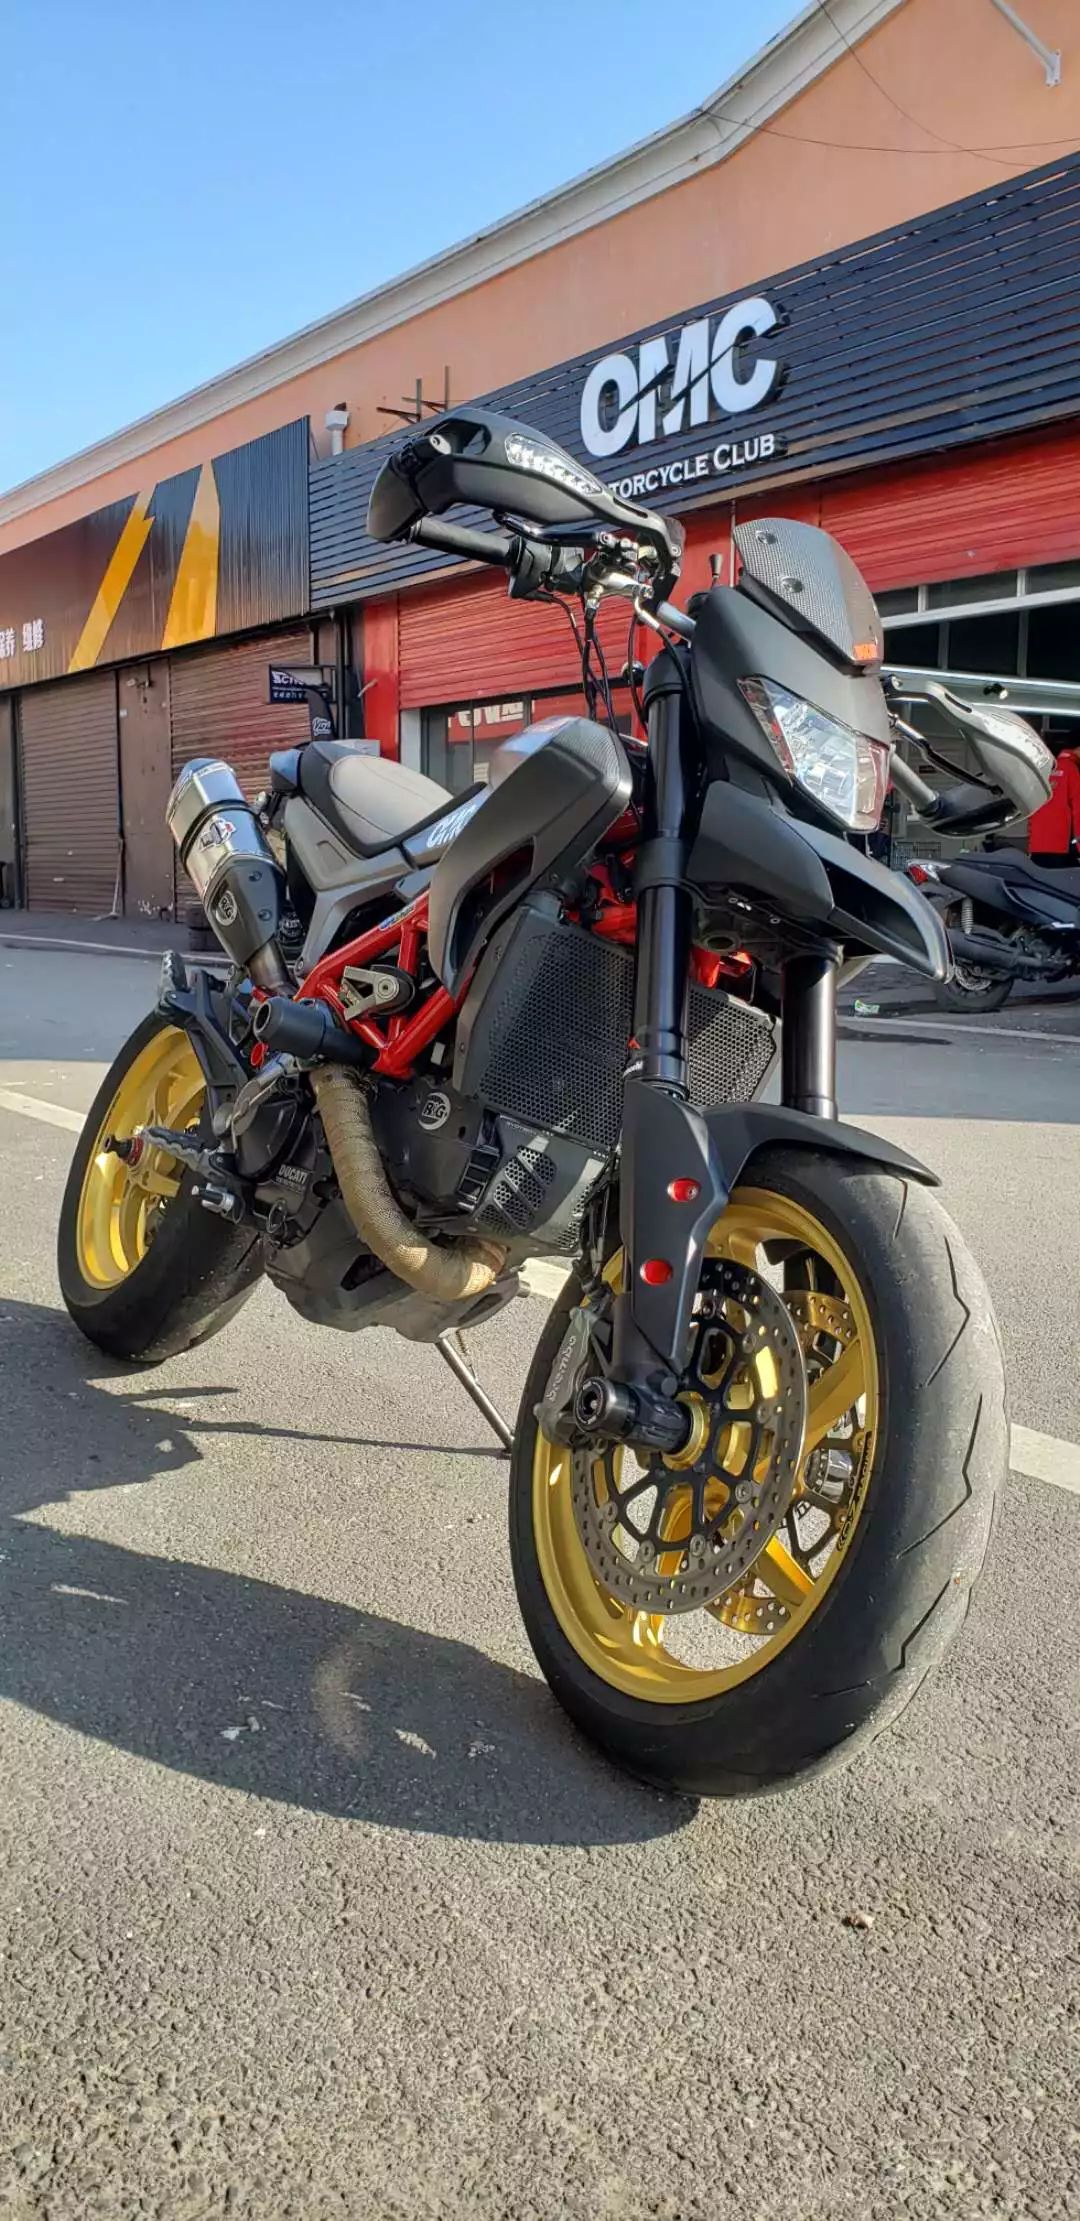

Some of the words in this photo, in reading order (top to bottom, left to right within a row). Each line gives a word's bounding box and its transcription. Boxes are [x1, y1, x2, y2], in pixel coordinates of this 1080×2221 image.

[580, 297, 780, 458] OMC
[607, 453, 710, 498] TORCYCLE
[713, 434, 775, 469] CLUB
[278, 1164, 308, 1185] DUCATI
[545, 1336, 577, 1402] brembo
